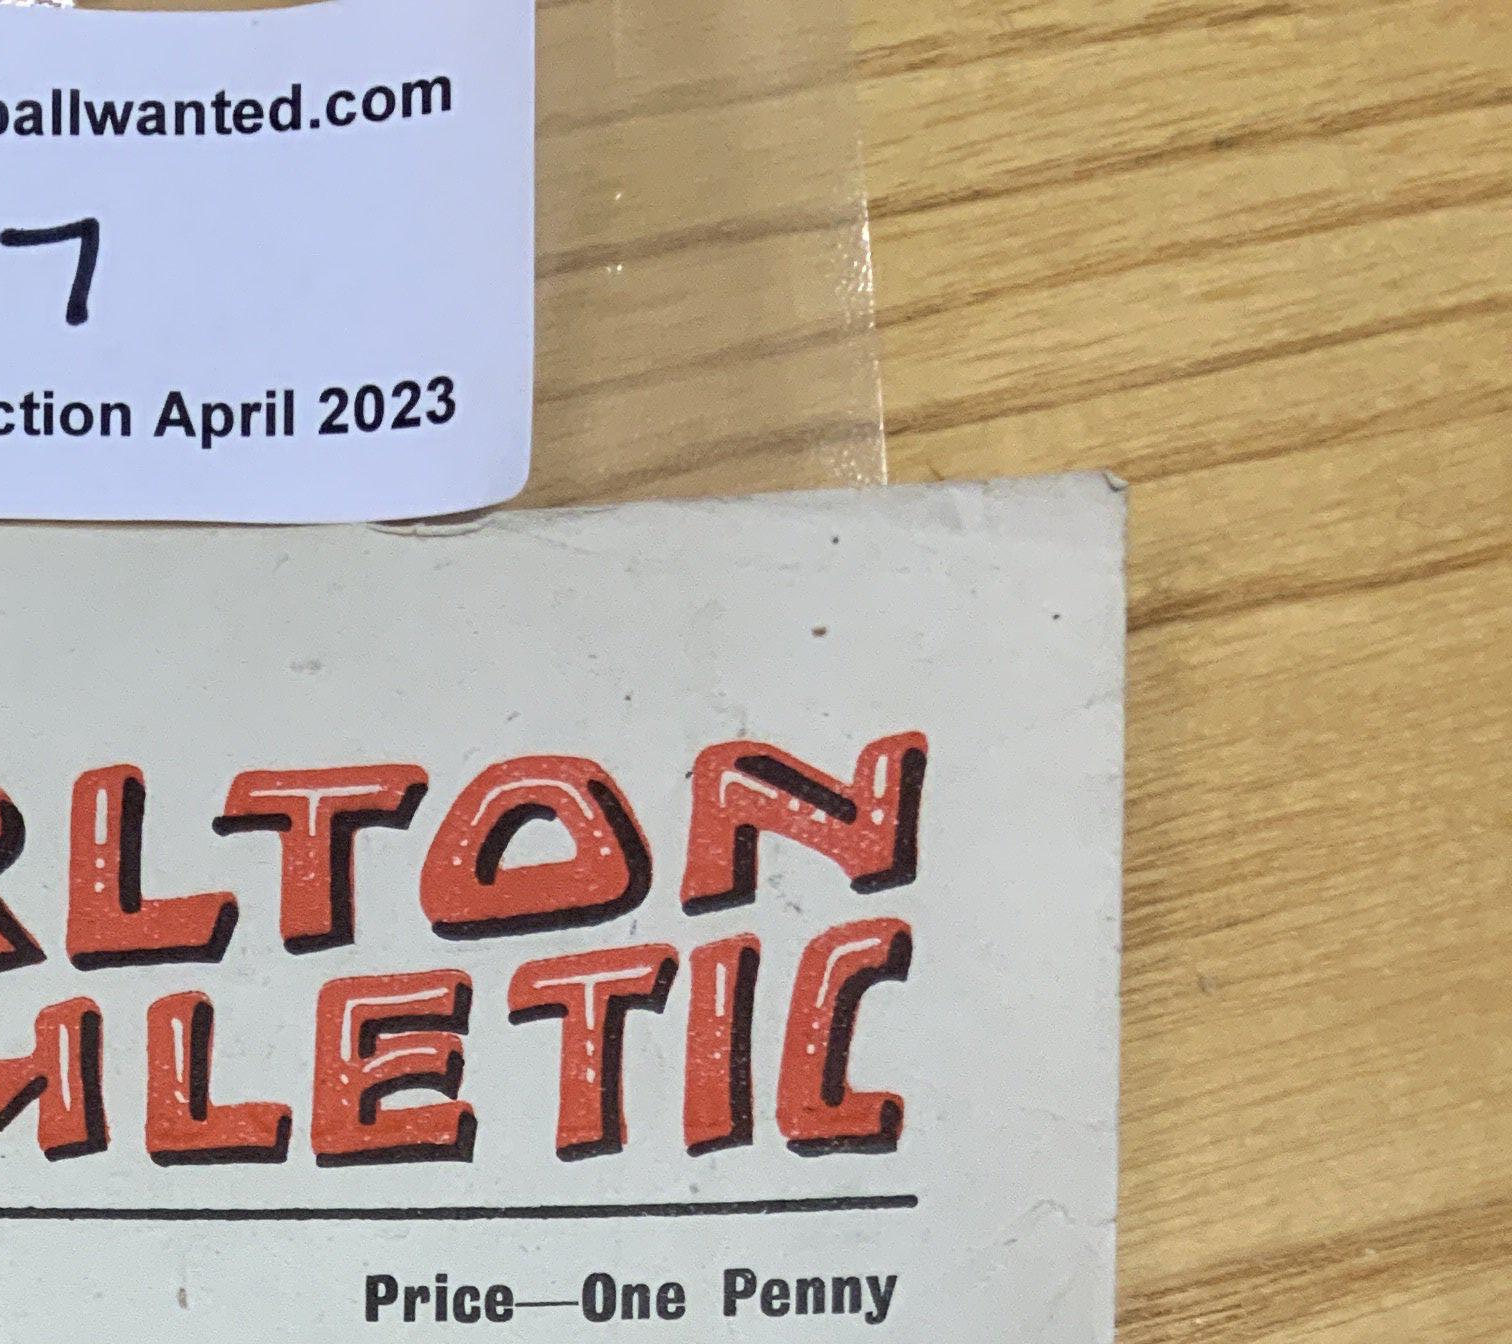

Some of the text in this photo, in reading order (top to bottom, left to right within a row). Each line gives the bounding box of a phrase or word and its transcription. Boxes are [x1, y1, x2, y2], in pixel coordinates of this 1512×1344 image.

[154, 389, 294, 449] April
[318, 376, 455, 435] 2023
[723, 1268, 898, 1325] Penny
